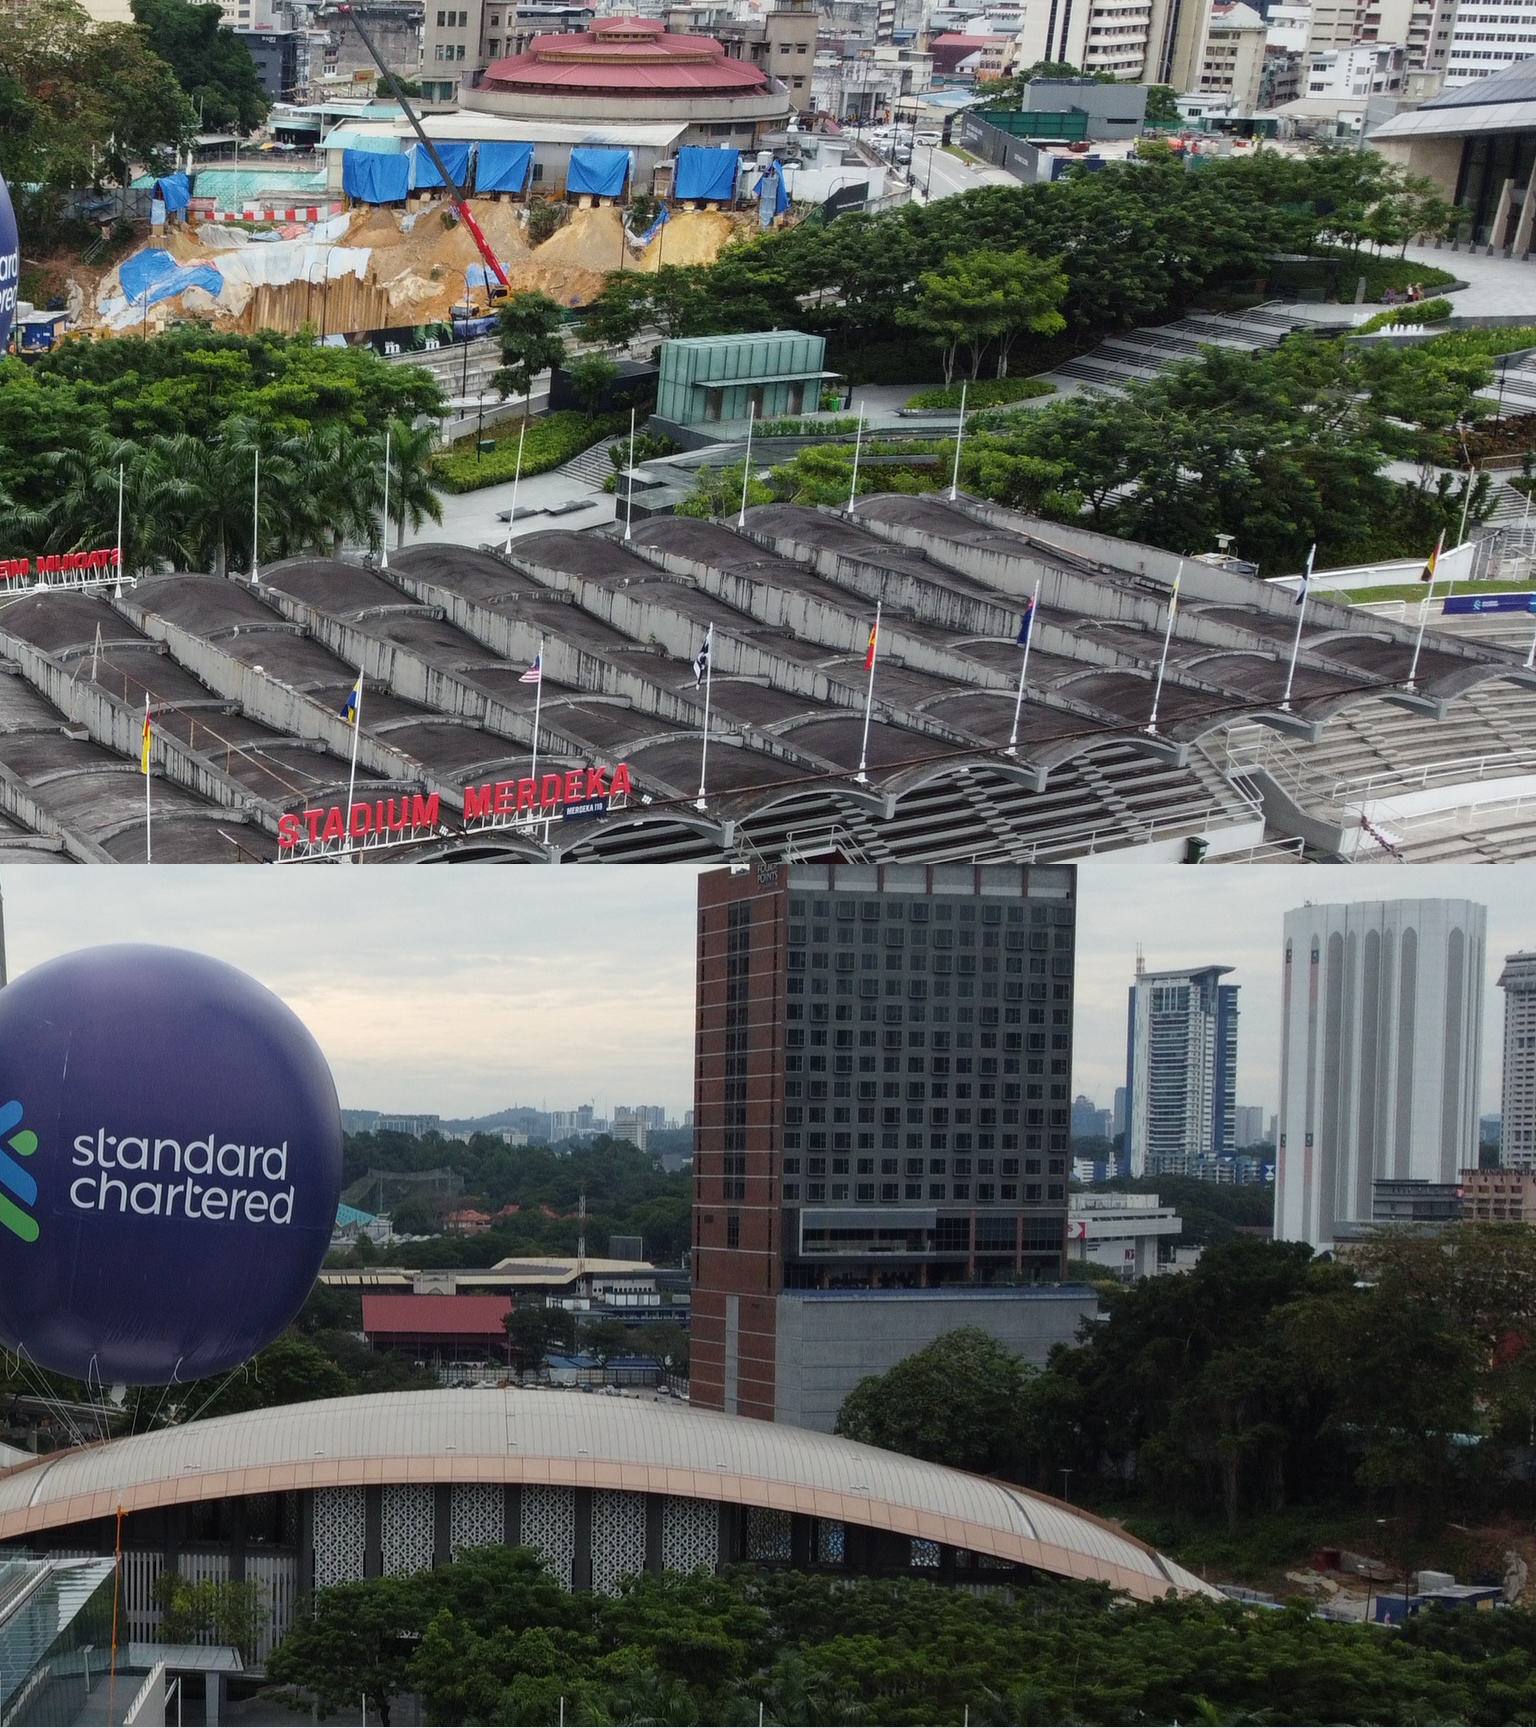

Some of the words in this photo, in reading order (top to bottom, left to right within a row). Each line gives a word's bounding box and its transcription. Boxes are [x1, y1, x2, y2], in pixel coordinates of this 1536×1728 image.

[277, 791, 440, 849] STADIUM
[464, 762, 631, 819] MERDEKA
[566, 804, 593, 816] MERDEKA
[72, 1127, 288, 1181] standard
[69, 1173, 295, 1225] chartered
